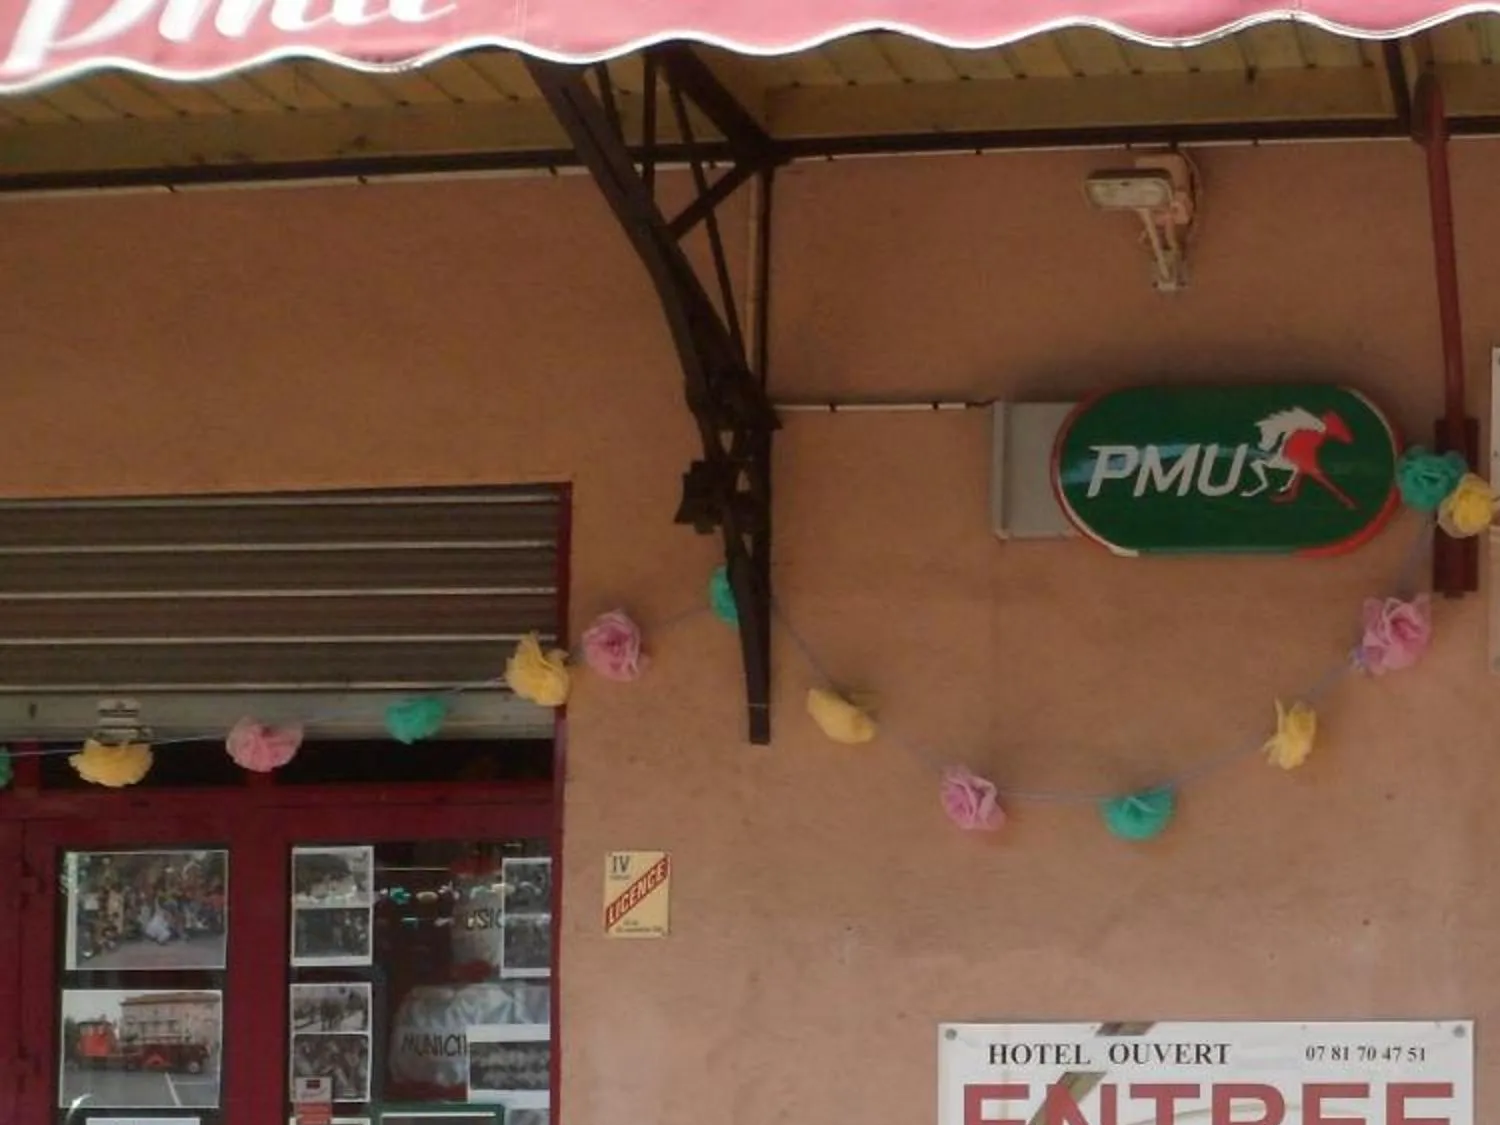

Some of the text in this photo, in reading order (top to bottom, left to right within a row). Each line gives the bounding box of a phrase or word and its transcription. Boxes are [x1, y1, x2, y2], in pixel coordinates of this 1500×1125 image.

[1086, 442, 1249, 499] PMU
[988, 1043, 1232, 1065] HOTEL OUVERT
[1305, 1046, 1426, 1062] 07 81 70 47 51
